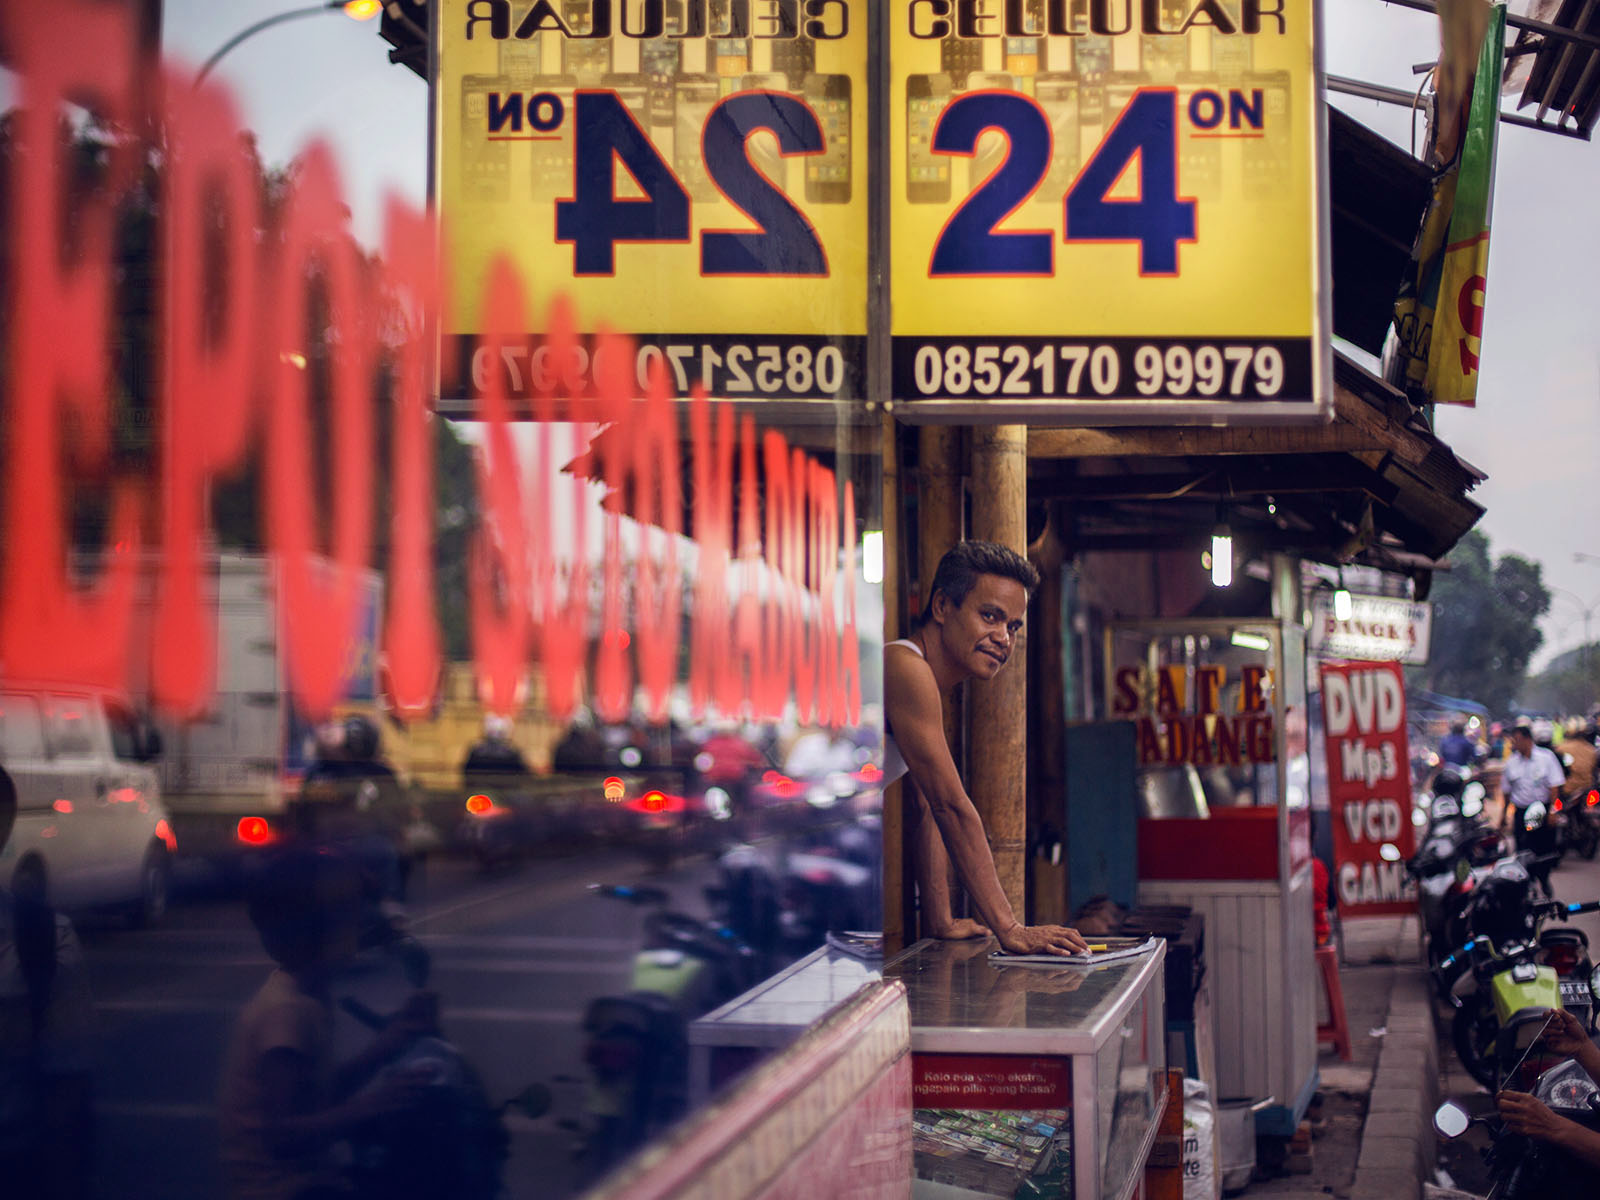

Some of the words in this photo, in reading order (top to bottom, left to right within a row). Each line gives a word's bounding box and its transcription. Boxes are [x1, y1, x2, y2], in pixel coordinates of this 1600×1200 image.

[907, 0, 1287, 39] CELLULAR
[928, 86, 1198, 278] 24
[1187, 88, 1264, 130] ON
[914, 344, 1120, 394] 0852170
[1134, 345, 1284, 396] 99979
[1114, 664, 1270, 714] SATE
[1322, 668, 1404, 736] DVD
[1342, 739, 1396, 788] Mp3
[1344, 800, 1401, 843] VCD
[989, 1085, 1017, 1096] yang
[1019, 1084, 1057, 1095] biasa?
